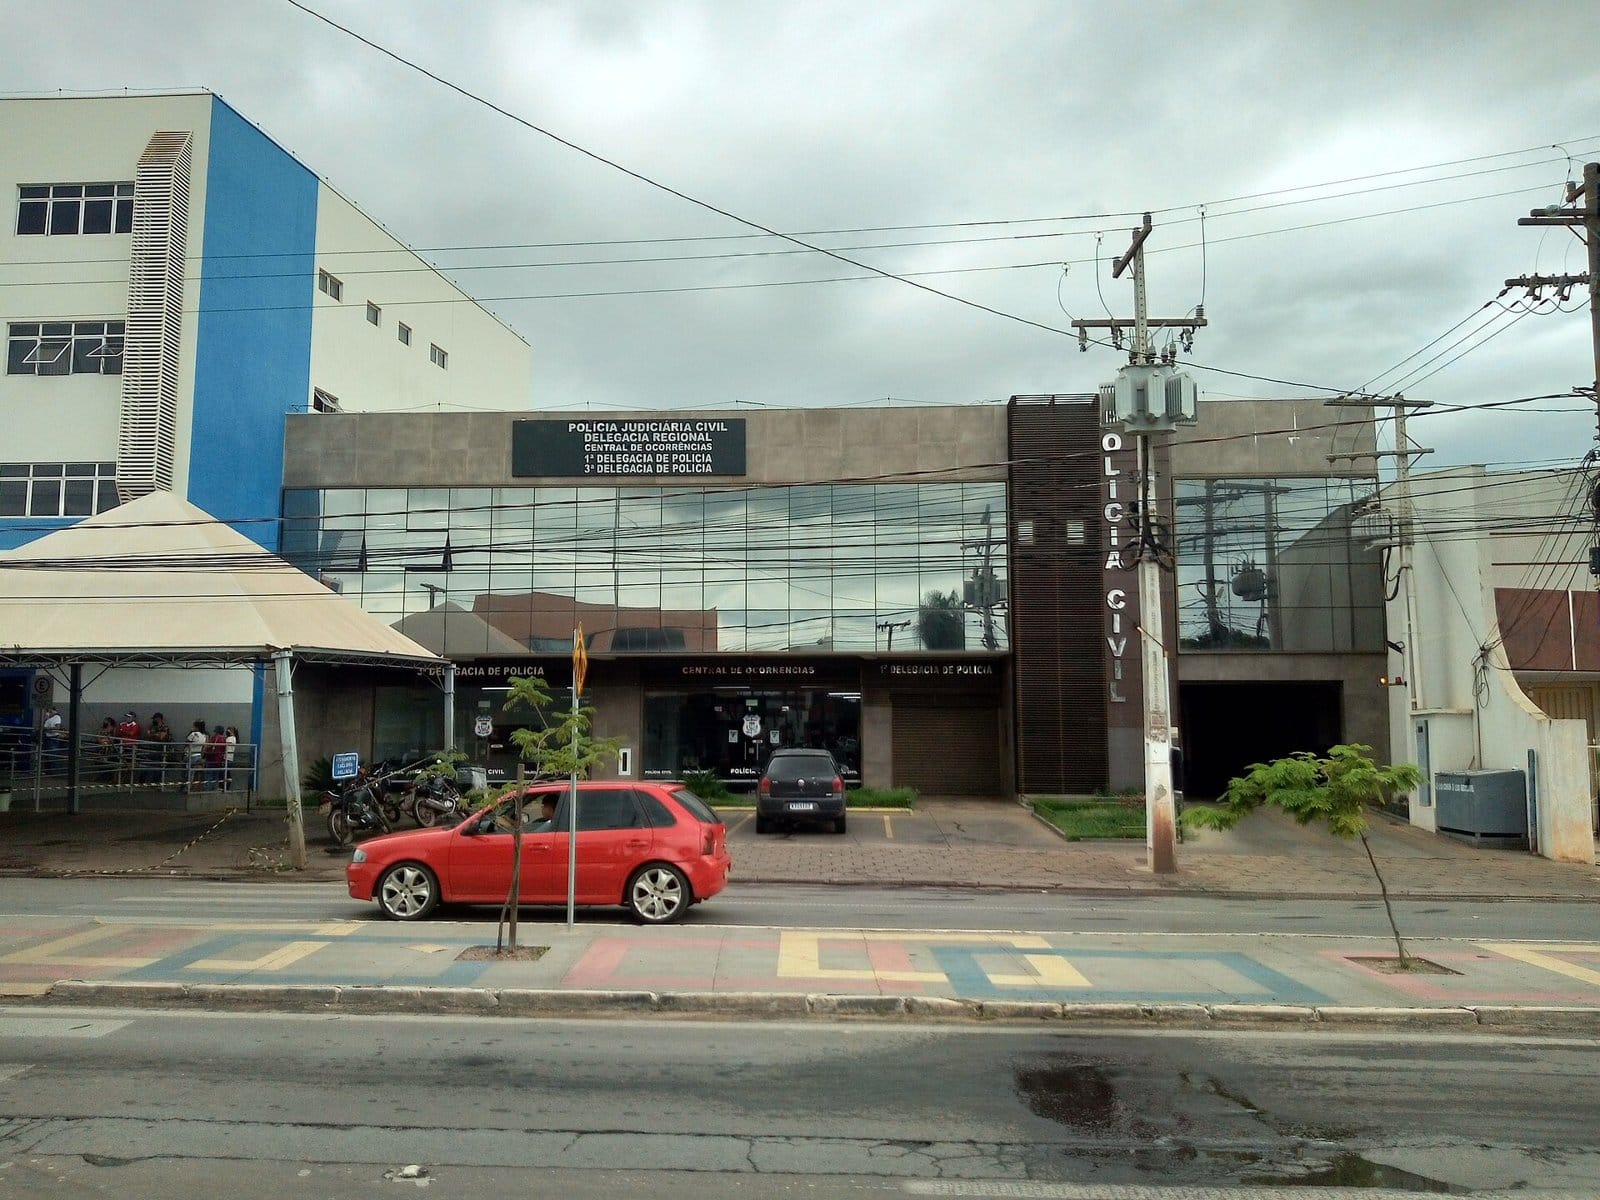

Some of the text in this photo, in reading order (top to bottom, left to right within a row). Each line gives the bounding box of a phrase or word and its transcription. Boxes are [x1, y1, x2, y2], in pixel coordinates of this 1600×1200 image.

[568, 420, 728, 432] POLÍCIA JUDICIÁRIA CIVIL
[584, 432, 713, 442] DELEGACIA REGIONAL
[584, 441, 713, 452] CENTRAL DE OCORRÊNCIAS
[584, 454, 594, 463] 1ª
[596, 453, 653, 463] DELEGACIA
[656, 453, 669, 463] DE
[584, 464, 594, 473] 3ª
[596, 464, 653, 473] DELEGACIA
[656, 464, 669, 473] DE
[1107, 589, 1127, 702] CIVIL
[429, 667, 485, 676] DELGACIA
[487, 667, 501, 676] DE
[682, 666, 727, 674] CENTRAL
[730, 666, 743, 674] DE
[890, 665, 939, 675] DELEGACIA
[942, 665, 954, 674] DE
